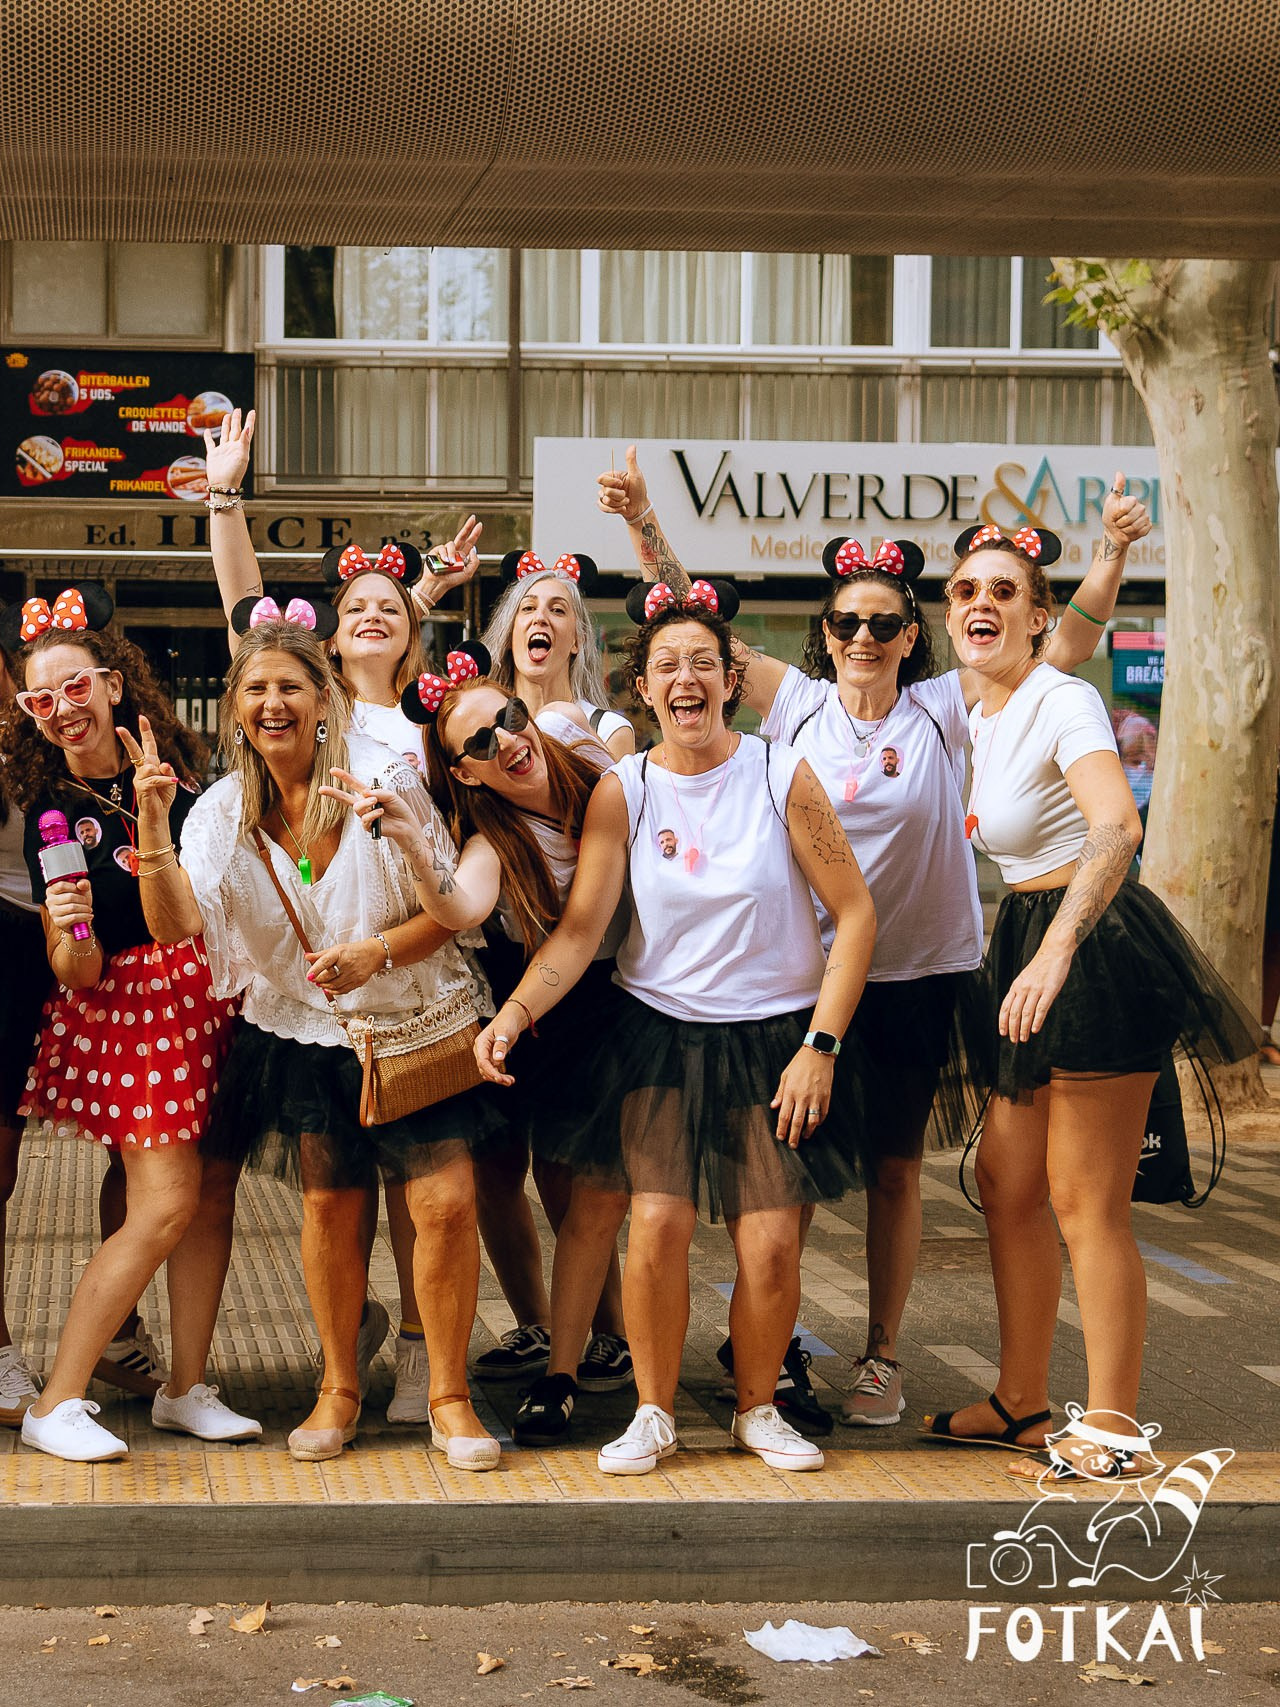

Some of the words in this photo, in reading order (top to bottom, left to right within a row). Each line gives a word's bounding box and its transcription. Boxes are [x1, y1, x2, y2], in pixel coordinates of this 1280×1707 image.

[118, 407, 186, 420] CROQUETTES
[131, 422, 146, 432] DE
[149, 422, 187, 433] VIANDE
[65, 447, 122, 459] FRIKANDEL
[65, 461, 109, 472] SPECIAL
[110, 480, 167, 492] FRIKANDEL
[671, 449, 980, 521] VALVERDE
[85, 524, 136, 546] Ed.
